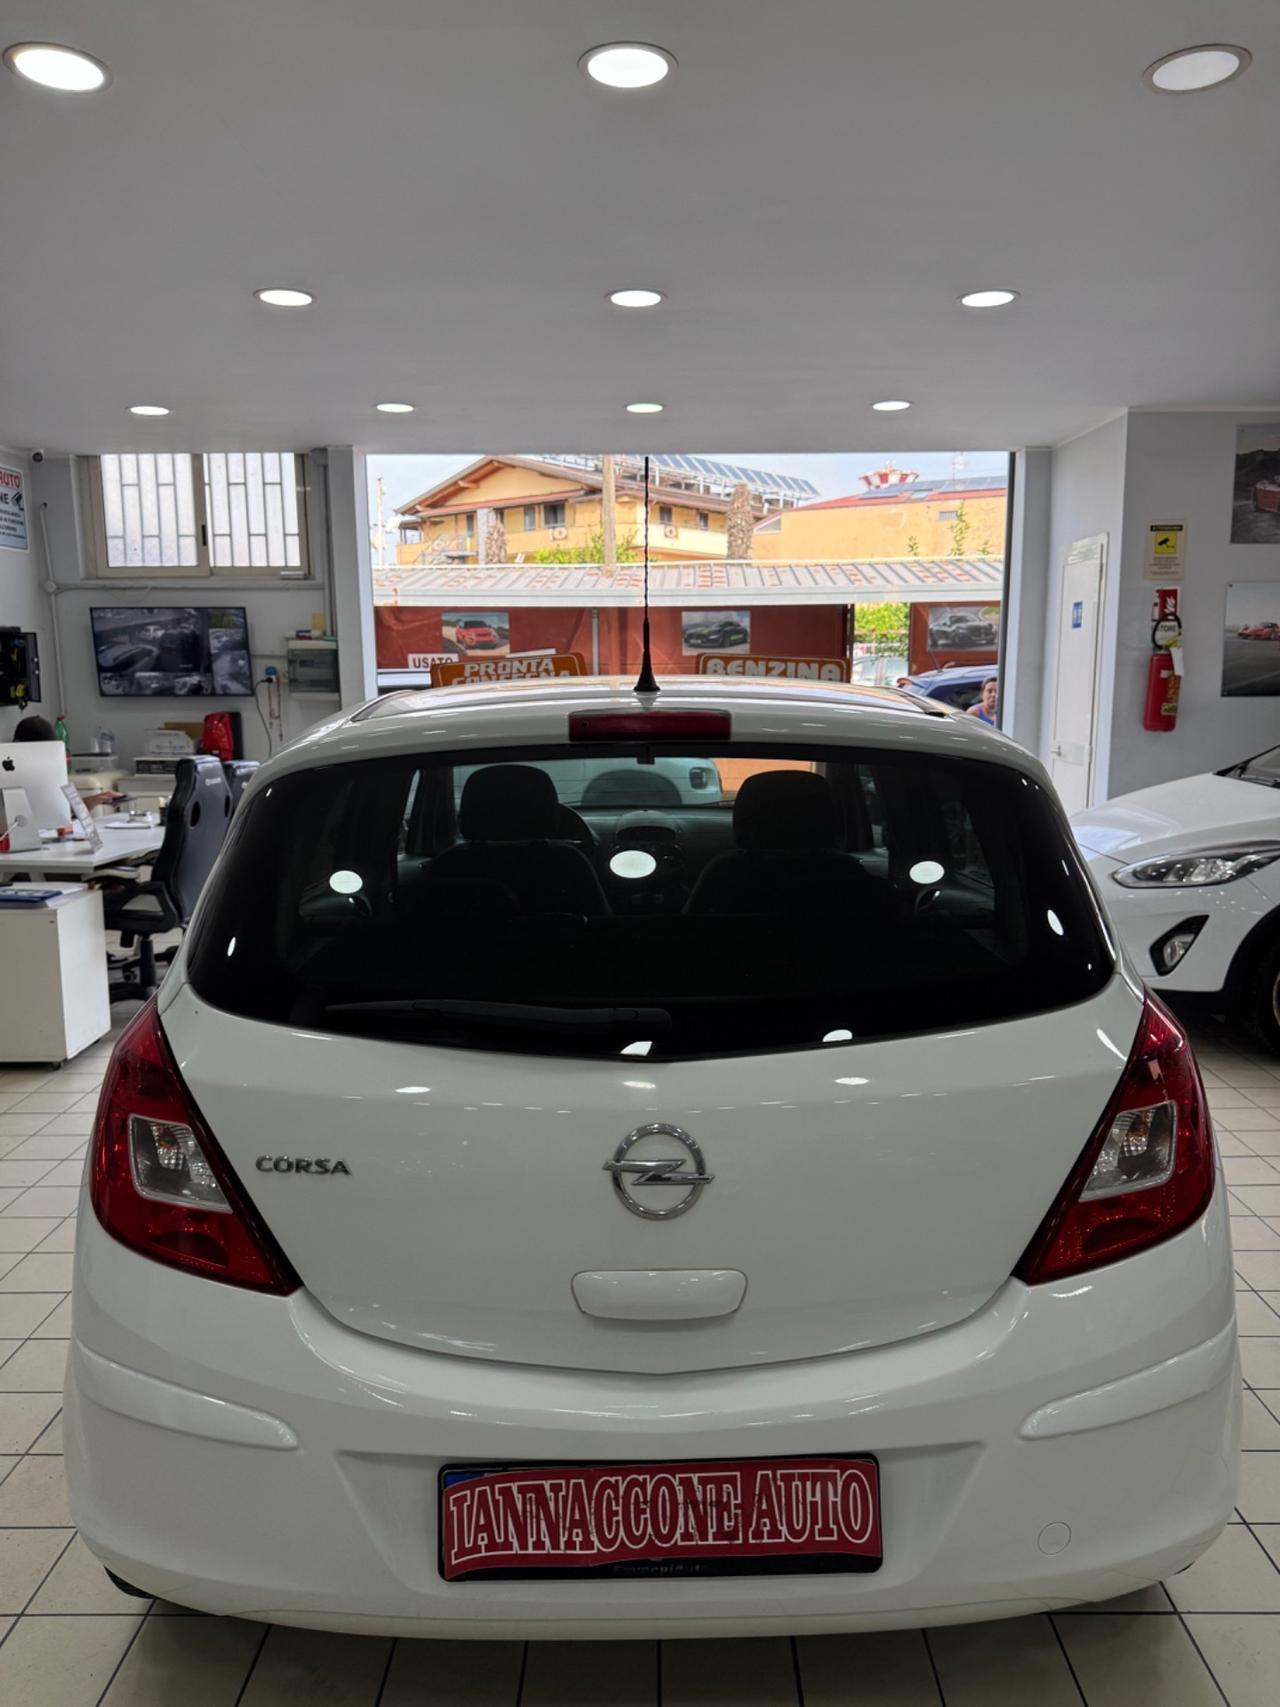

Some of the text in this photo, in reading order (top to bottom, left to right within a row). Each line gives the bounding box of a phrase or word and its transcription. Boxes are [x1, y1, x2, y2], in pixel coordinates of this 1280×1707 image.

[464, 659, 555, 677] PRONTA
[706, 658, 841, 681] BENZINA
[255, 1154, 352, 1176] CORSA
[450, 1469, 874, 1566] IANNACCONE AUTO
